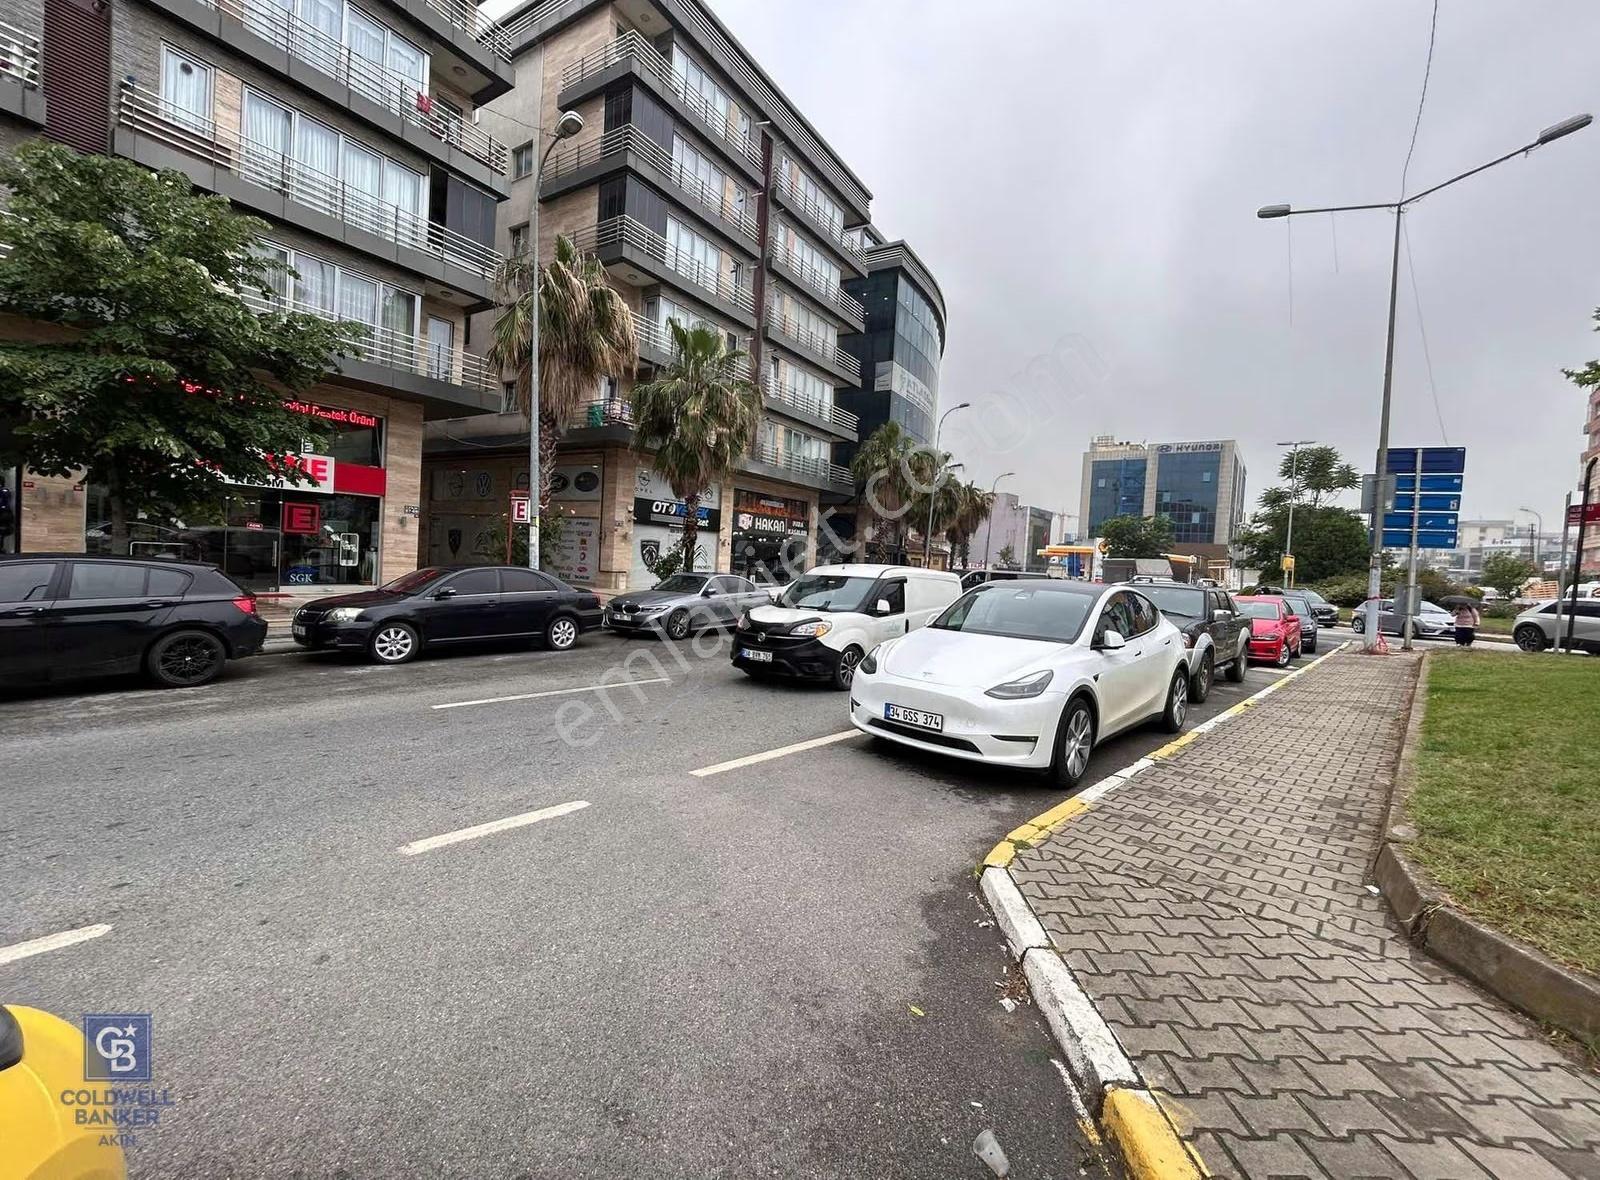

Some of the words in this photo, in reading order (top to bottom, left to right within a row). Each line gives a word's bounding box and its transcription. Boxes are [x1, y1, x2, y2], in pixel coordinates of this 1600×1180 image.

[1176, 443, 1223, 452] HYUNDAI
[755, 517, 785, 532] HAKAN
[289, 573, 313, 583] SGK
[890, 706, 900, 719] 34
[903, 710, 919, 723] GSS
[923, 714, 940, 728] 374
